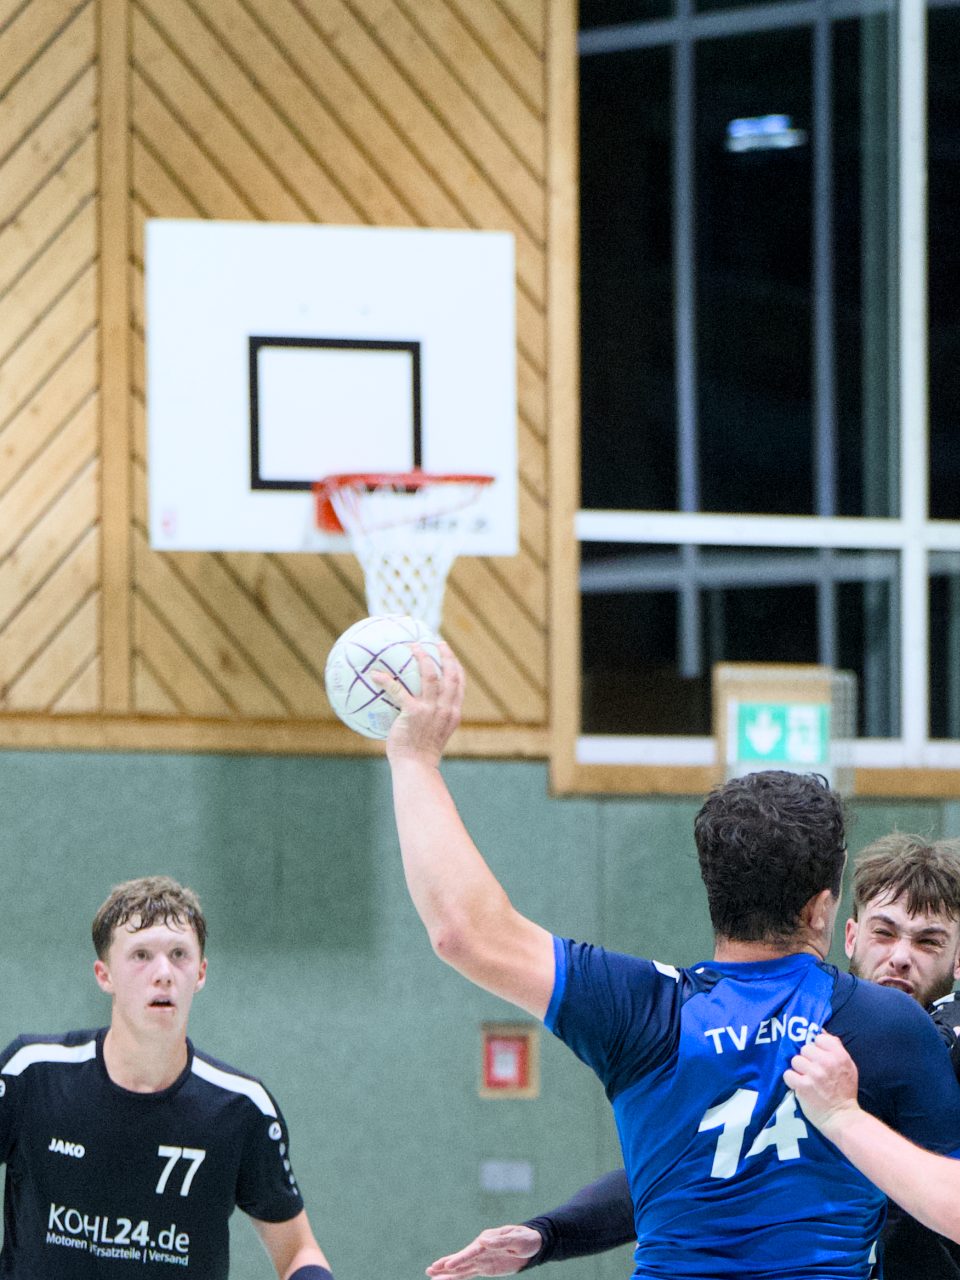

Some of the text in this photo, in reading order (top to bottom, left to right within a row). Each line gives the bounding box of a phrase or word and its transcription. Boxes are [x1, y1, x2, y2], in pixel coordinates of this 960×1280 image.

[704, 1025, 748, 1054] TV
[49, 1138, 85, 1158] JAKO
[698, 1088, 808, 1178] 14
[156, 1145, 206, 1196] 77
[49, 1203, 190, 1252] KOHL24.de
[46, 1232, 87, 1249] Motoren
[149, 1250, 189, 1266] Versand
